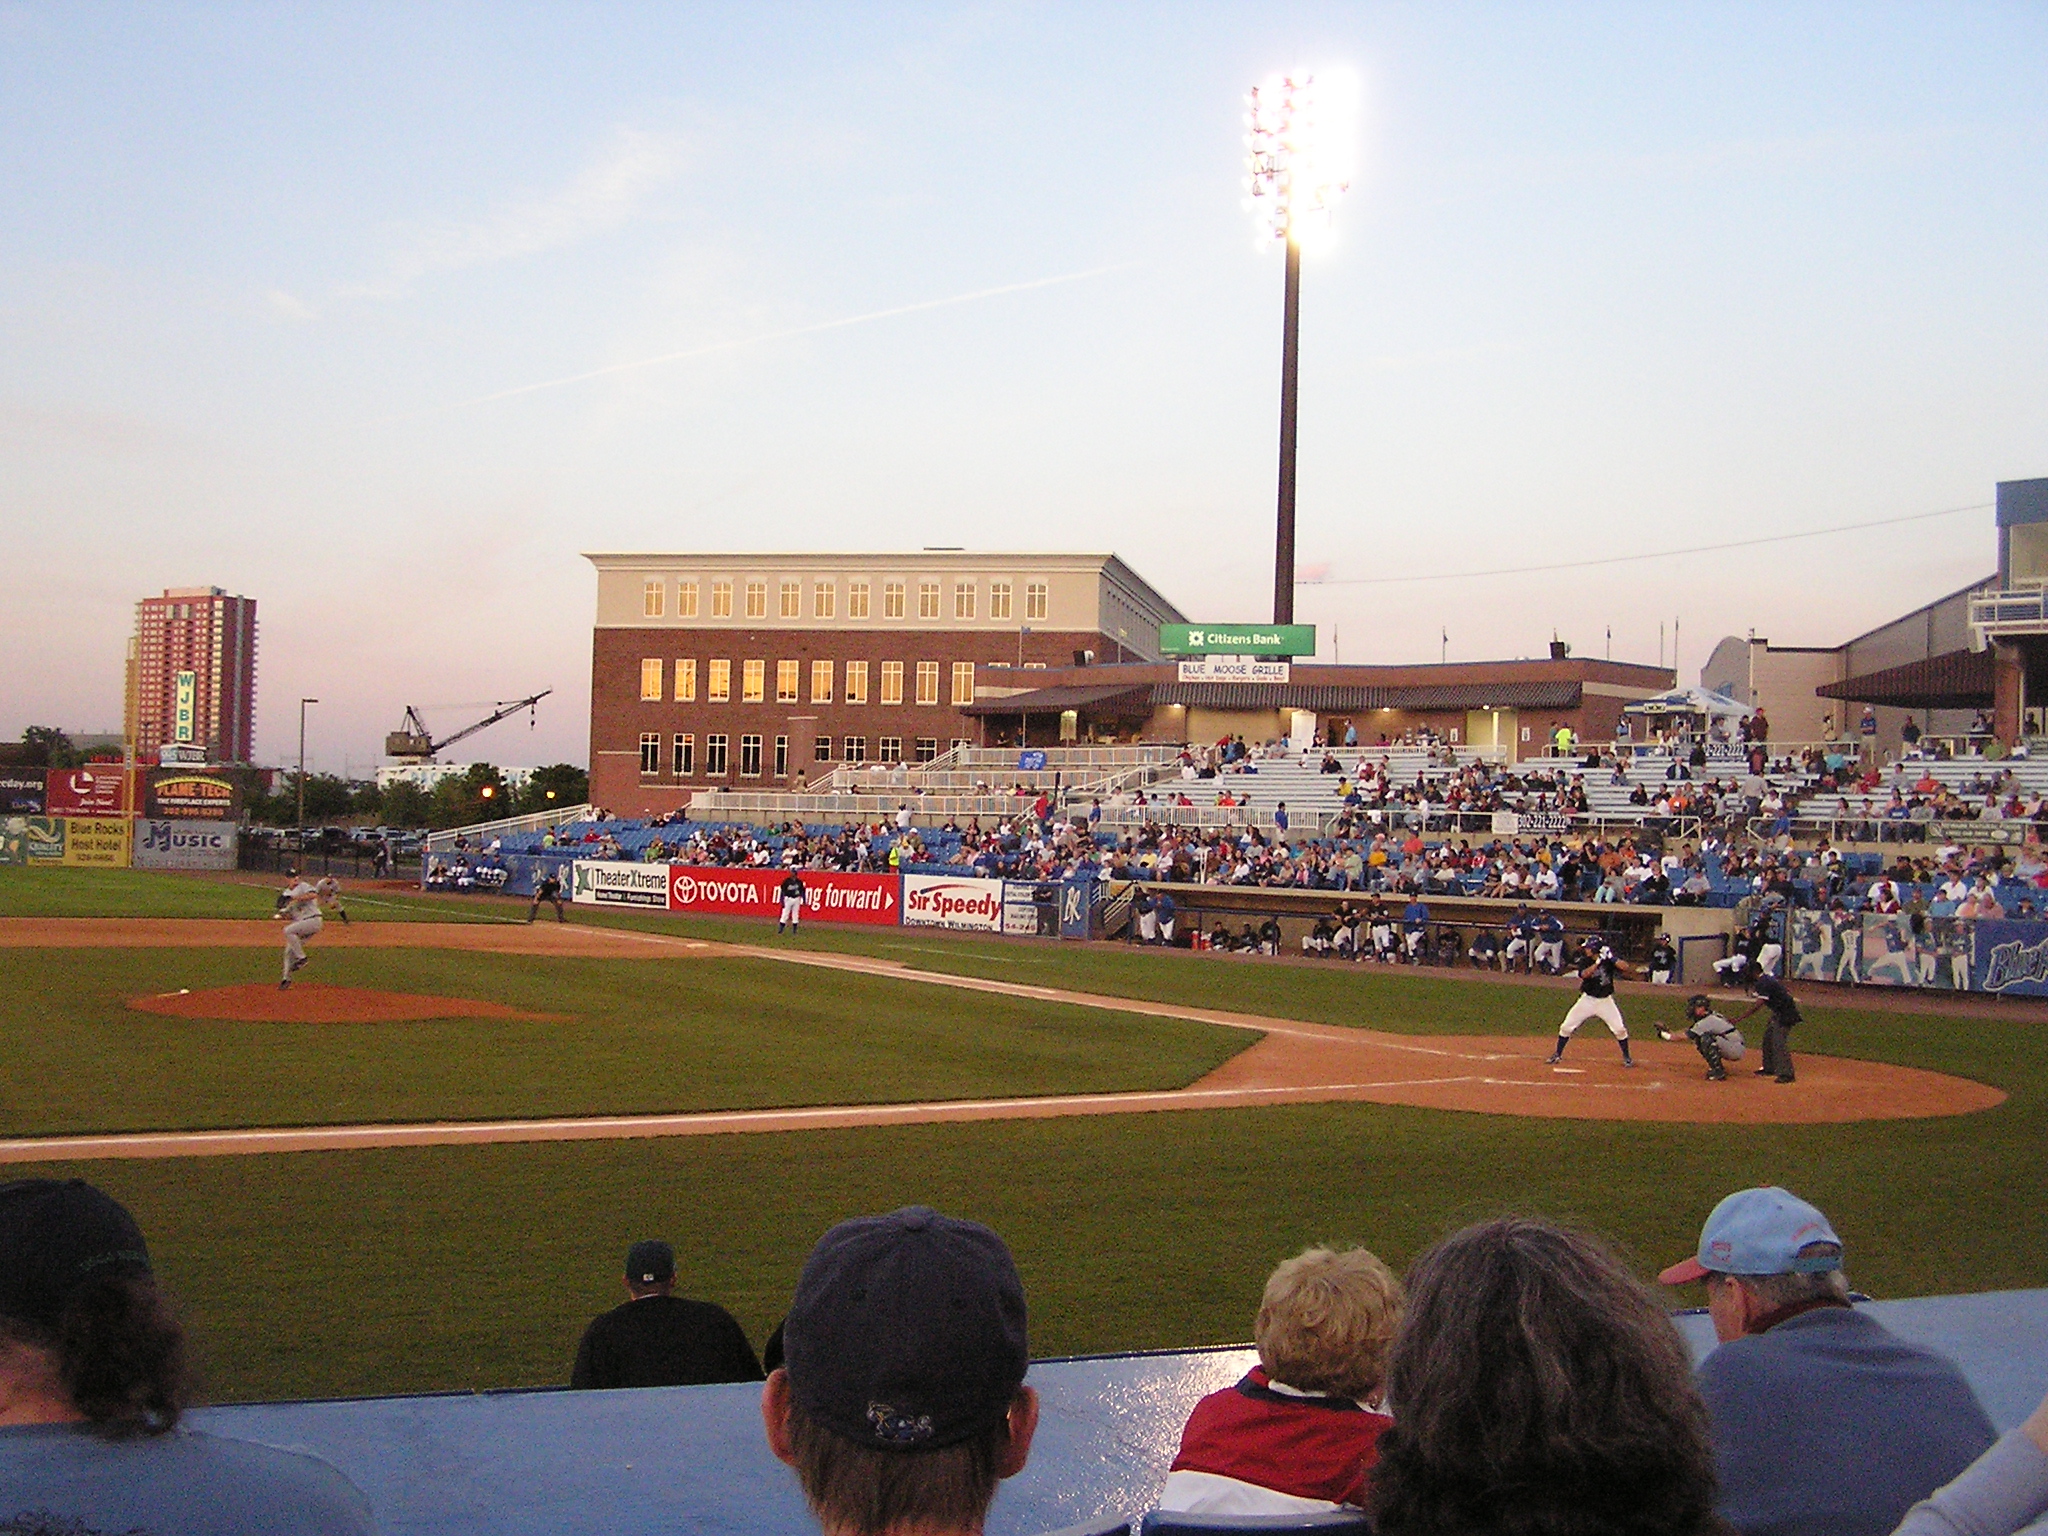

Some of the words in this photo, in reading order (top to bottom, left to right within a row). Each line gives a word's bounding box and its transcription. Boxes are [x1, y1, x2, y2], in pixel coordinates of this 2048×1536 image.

[1207, 633, 1252, 645] Citizens
[1253, 633, 1281, 645] Bank
[1182, 664, 1206, 674] BLUE
[1213, 664, 1246, 675] MOOSE
[1252, 665, 1284, 676] GRILLE
[178, 674, 194, 739] WJBR
[71, 822, 91, 834] Blue
[95, 822, 124, 836] Rocks
[71, 839, 94, 850] Host
[96, 839, 121, 850] Hotel
[698, 881, 759, 903] TOYOTA
[825, 883, 882, 910] forward
[908, 890, 930, 910] Sir
[932, 893, 1001, 921] Speedy
